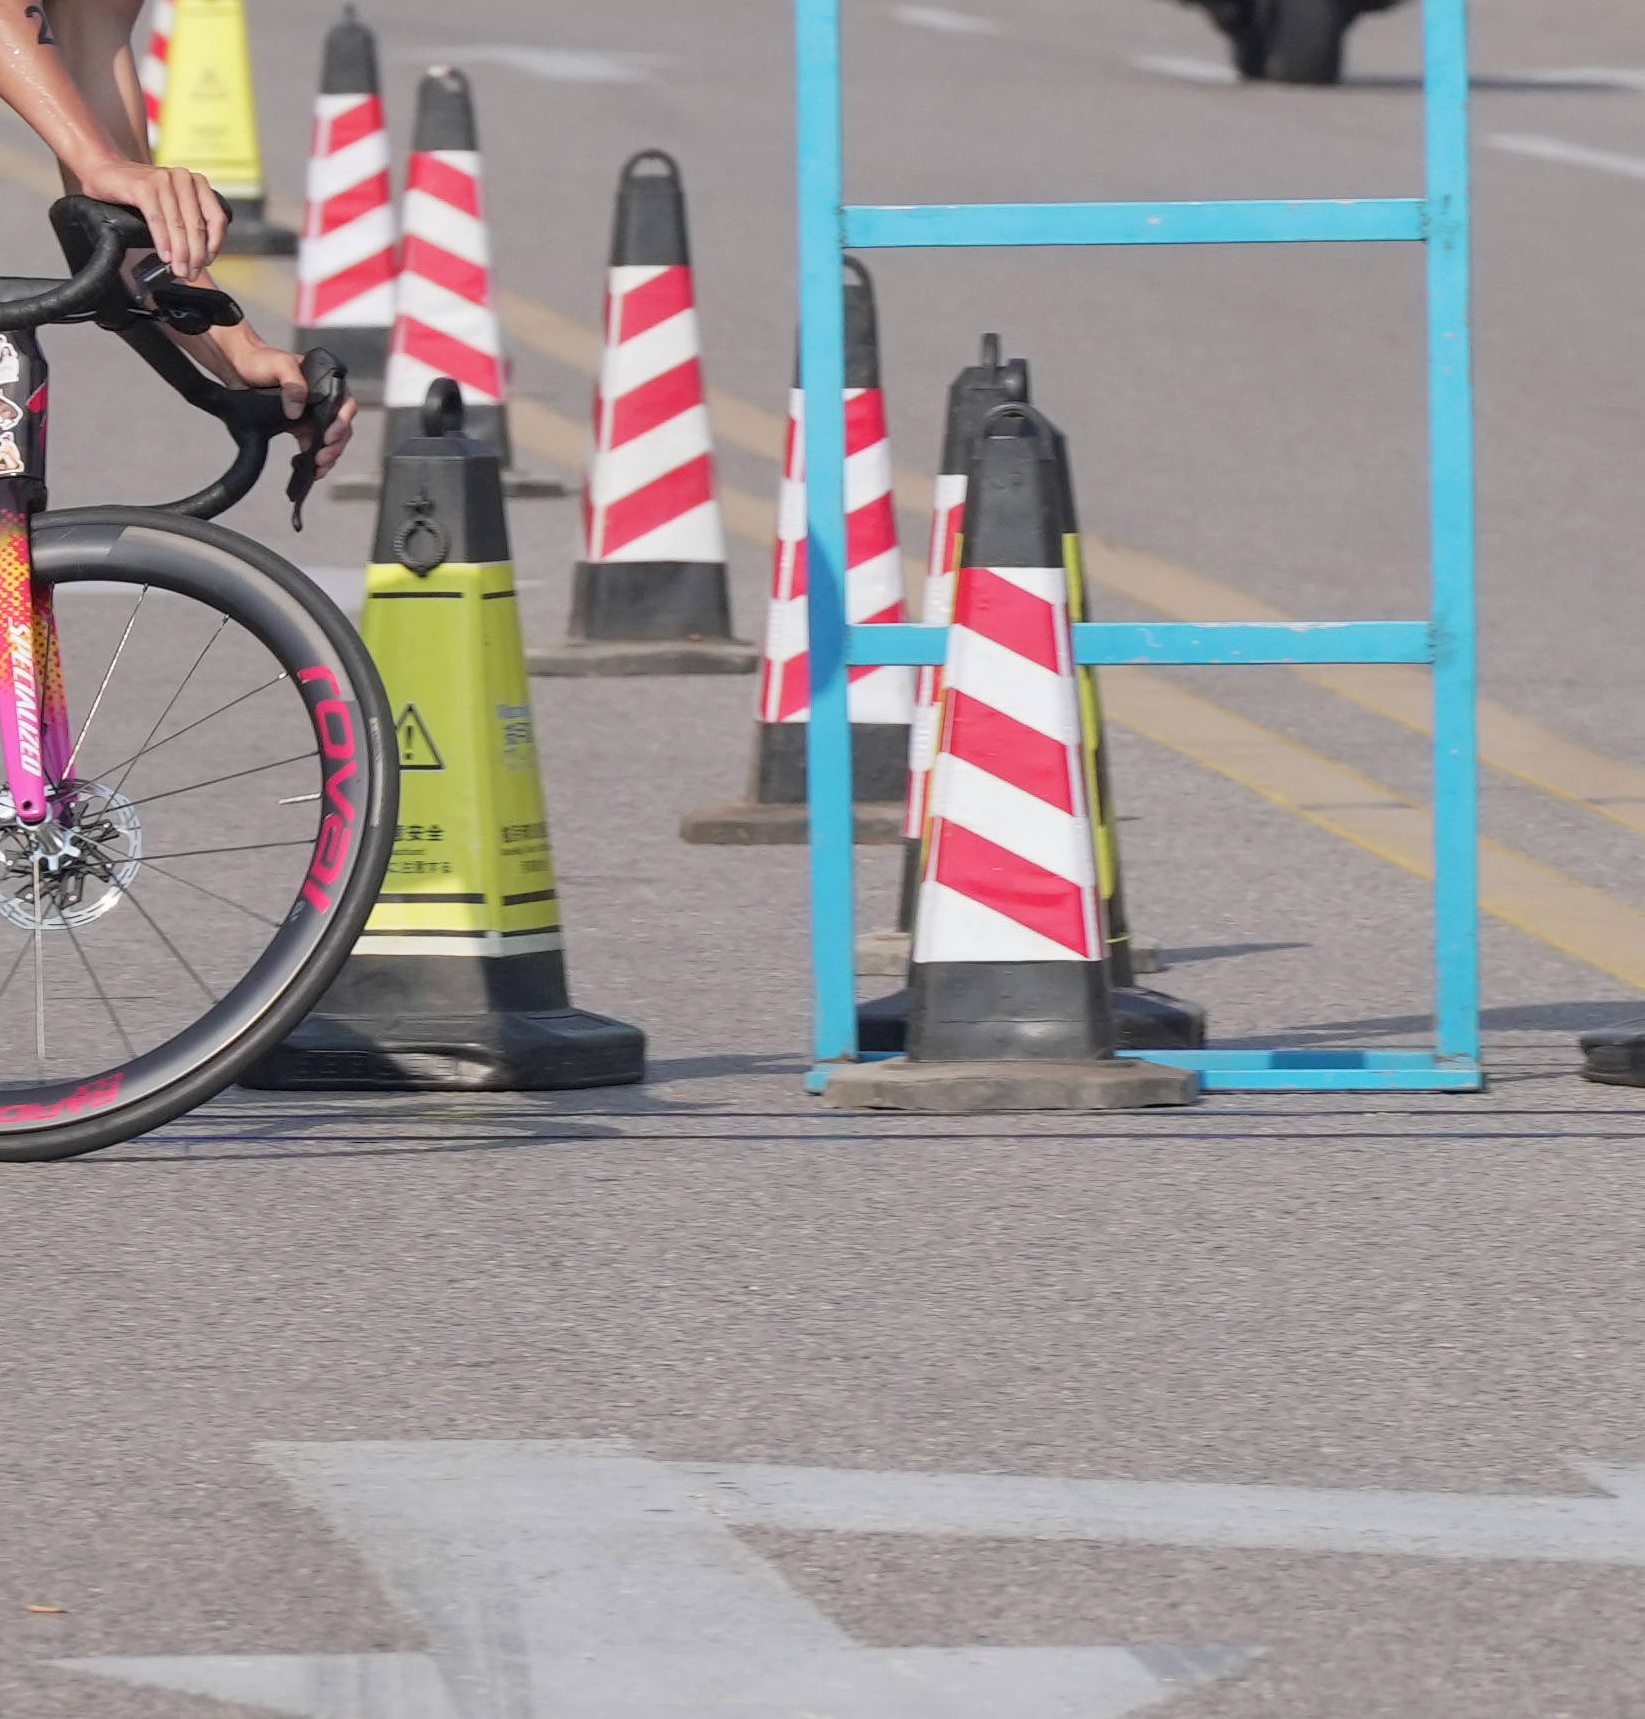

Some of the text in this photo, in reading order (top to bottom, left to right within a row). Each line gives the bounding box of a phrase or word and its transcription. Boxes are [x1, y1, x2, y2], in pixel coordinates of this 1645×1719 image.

[23, 4, 56, 45] 2
[7, 616, 43, 778] SPECIALIZED
[297, 664, 358, 915] roval
